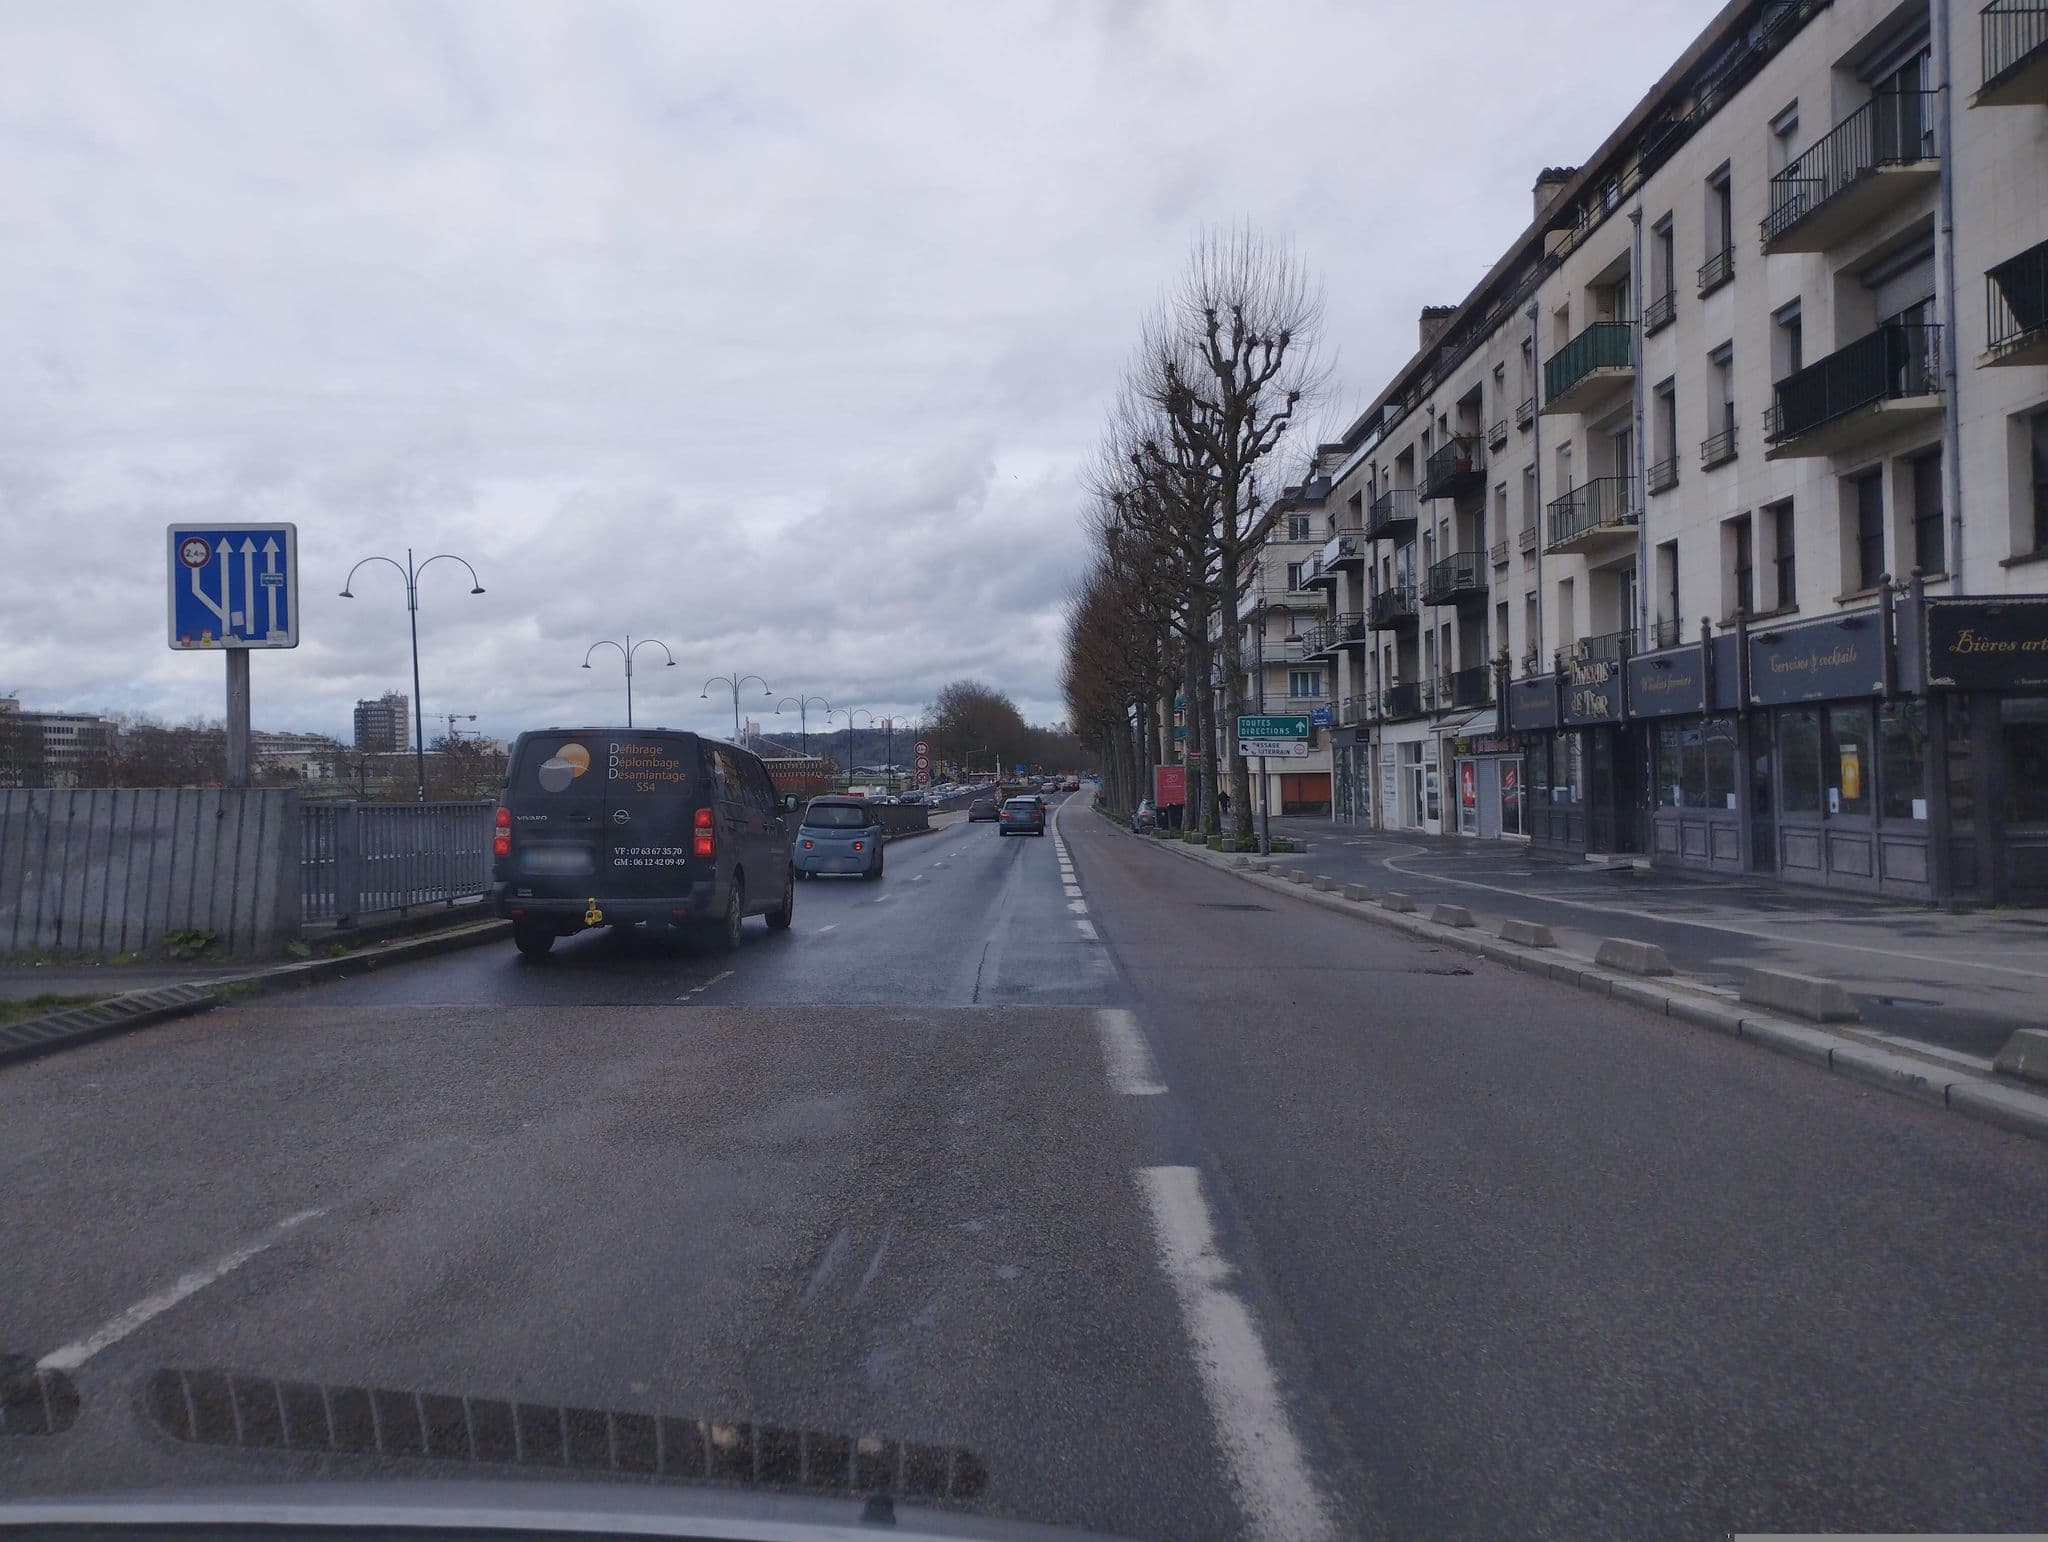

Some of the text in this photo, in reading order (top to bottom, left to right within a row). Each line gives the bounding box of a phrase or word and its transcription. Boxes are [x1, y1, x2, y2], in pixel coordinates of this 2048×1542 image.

[1948, 628, 2017, 655] Bières
[1241, 719, 1271, 727] TOUTES
[1241, 727, 1290, 735] DIRECTIONS
[635, 782, 656, 792] SS4
[630, 847, 640, 855] 07
[641, 847, 650, 855] 63
[651, 847, 661, 855] 67
[662, 847, 672, 855] 35
[672, 847, 682, 855] 70
[633, 858, 643, 866] 06
[644, 858, 653, 866] 12
[654, 858, 664, 866] 42
[664, 858, 674, 866] 09
[675, 858, 685, 866] 49
